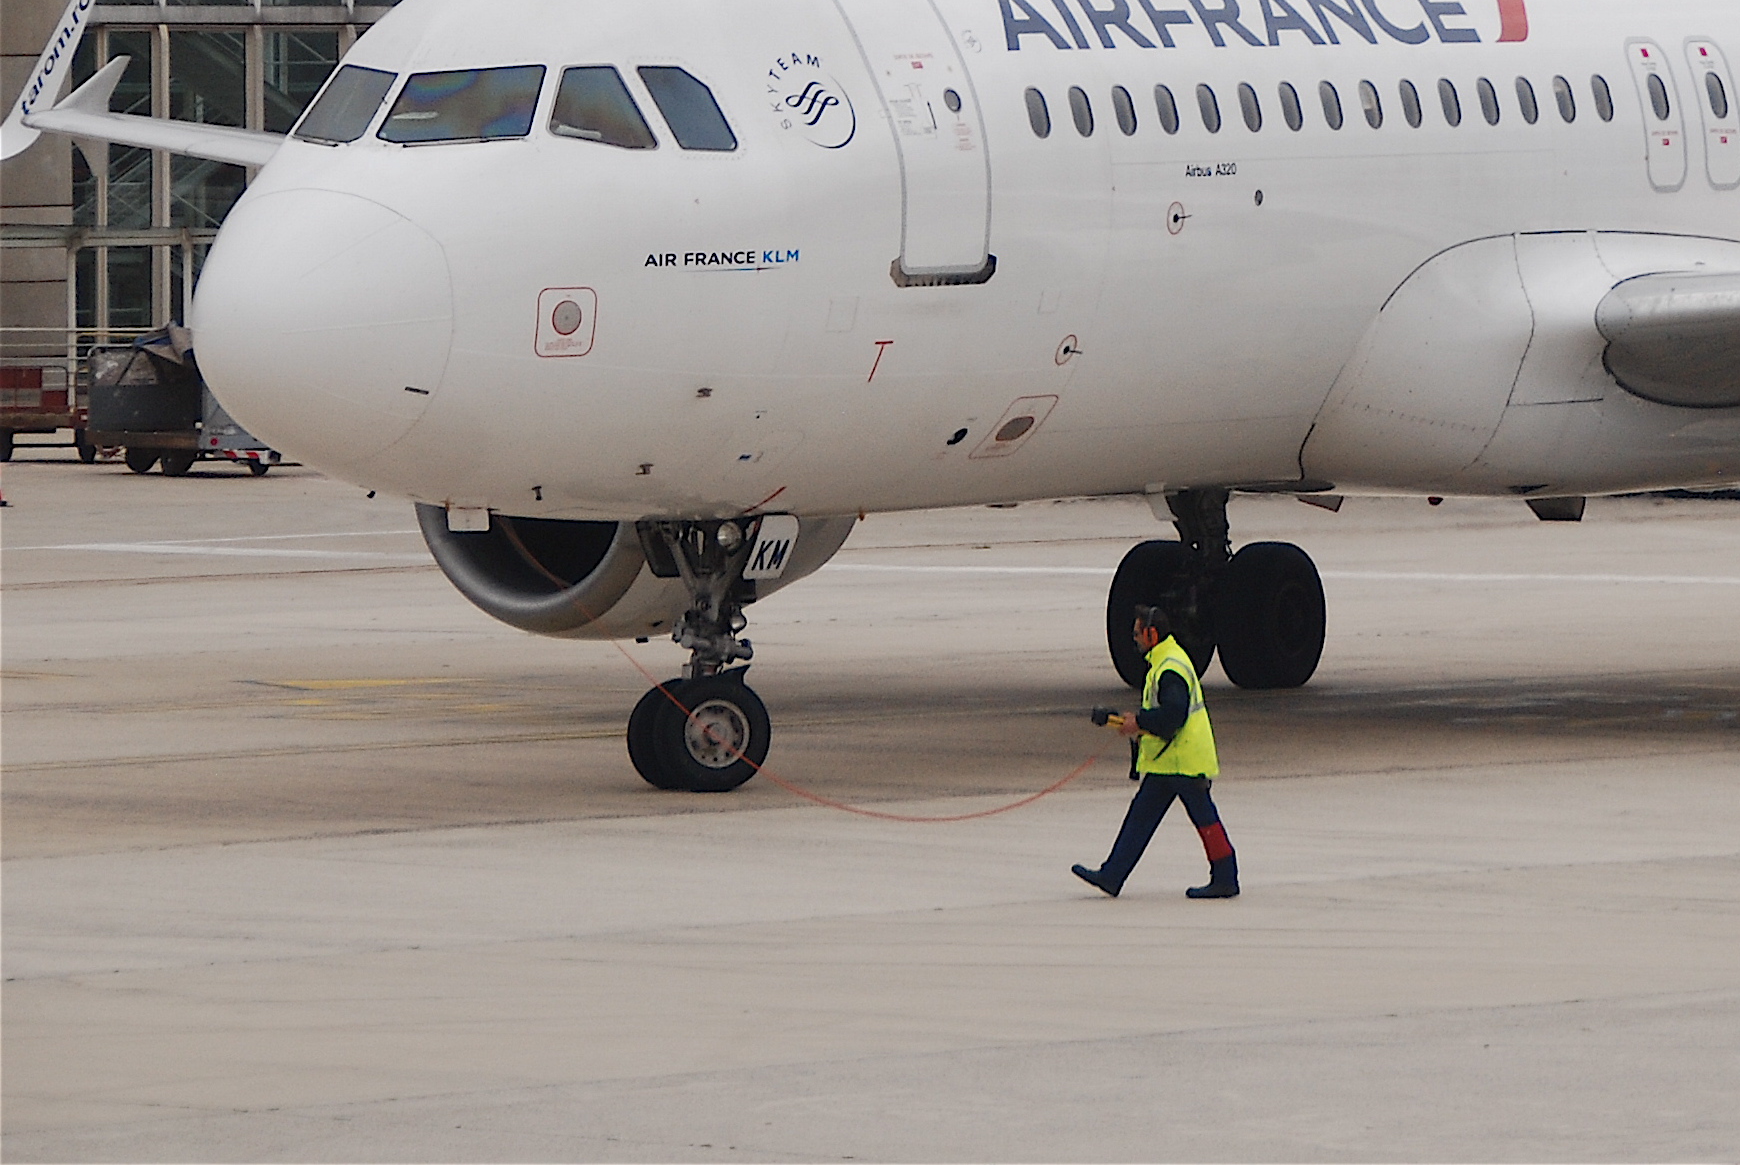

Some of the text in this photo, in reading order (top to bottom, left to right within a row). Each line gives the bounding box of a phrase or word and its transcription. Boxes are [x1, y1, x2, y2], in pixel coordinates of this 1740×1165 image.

[767, 52, 820, 130] SKYTEAM
[1185, 162, 1237, 177] Airbus A320
[645, 249, 800, 267] AIR FRANCE KLM
[751, 540, 790, 571] KM
